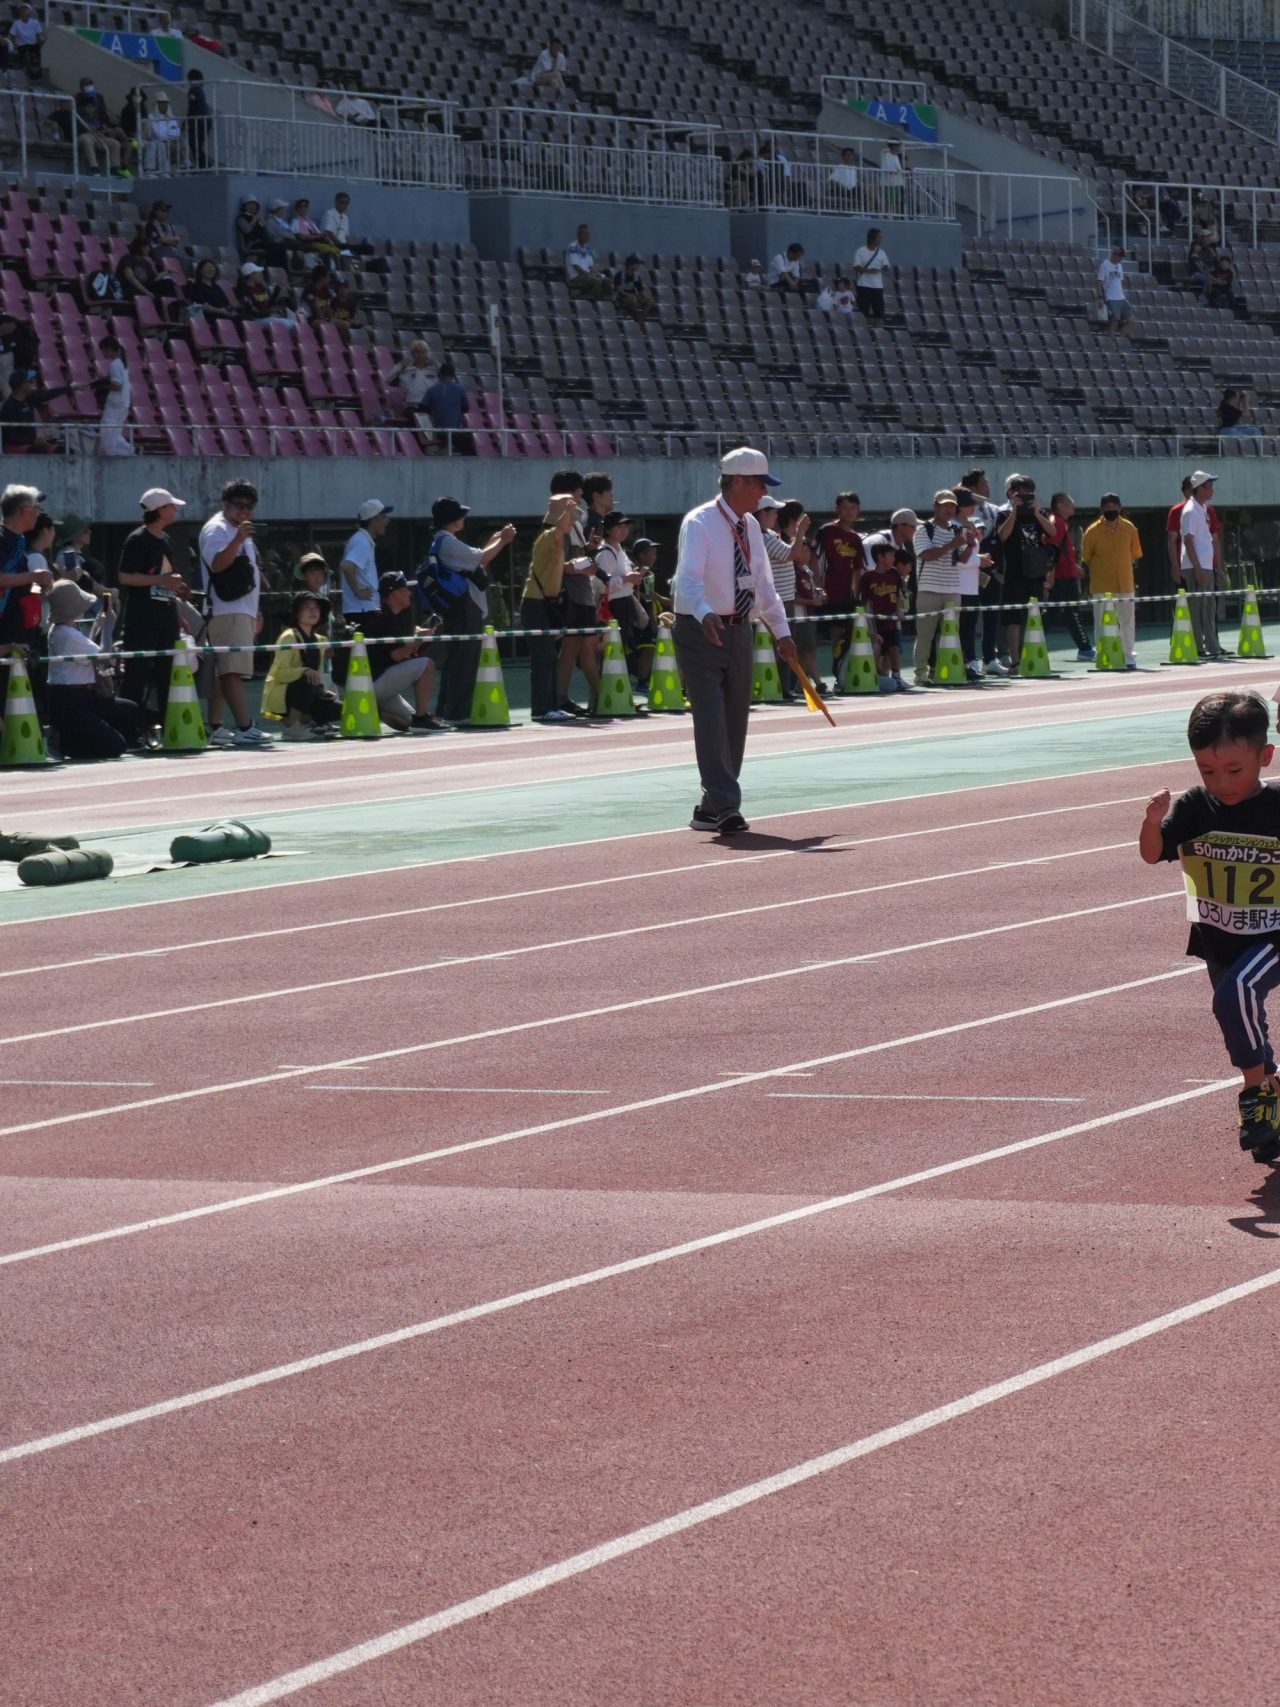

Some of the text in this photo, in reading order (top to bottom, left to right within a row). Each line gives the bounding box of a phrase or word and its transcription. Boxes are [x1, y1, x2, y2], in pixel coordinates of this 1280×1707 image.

[111, 34, 148, 58] A 3
[876, 103, 908, 124] A 2
[1203, 861, 1275, 905] 112
